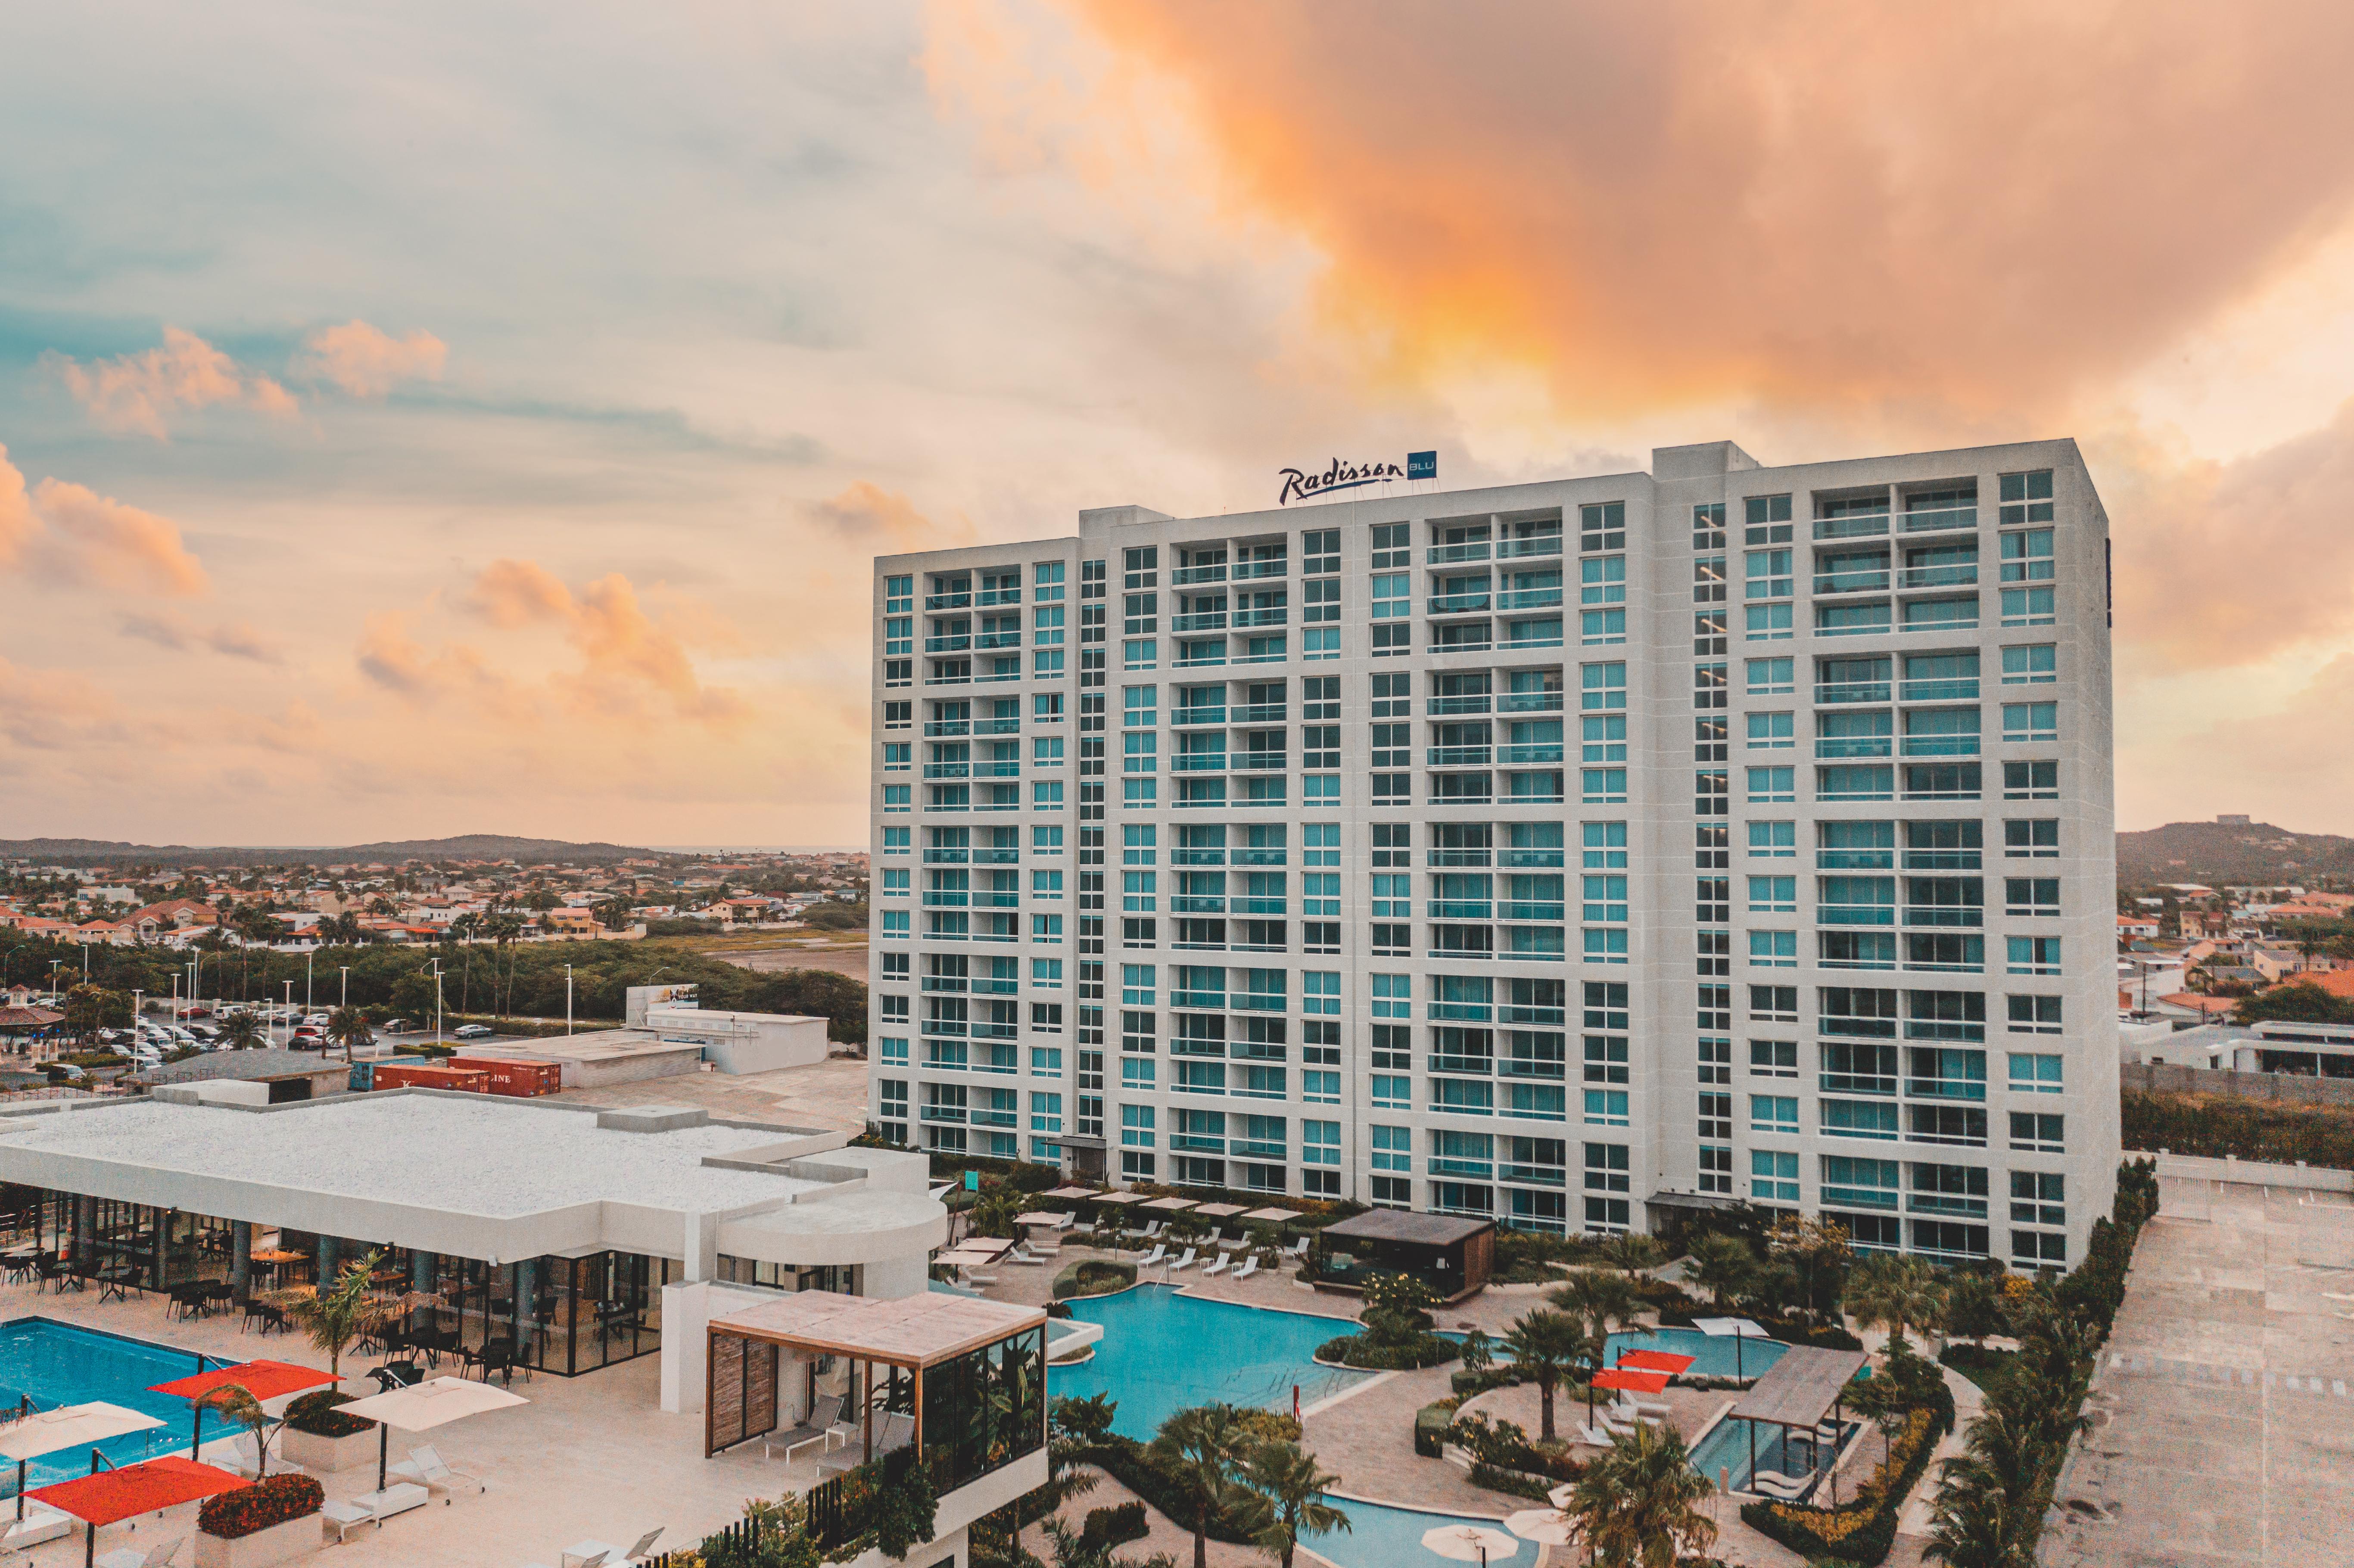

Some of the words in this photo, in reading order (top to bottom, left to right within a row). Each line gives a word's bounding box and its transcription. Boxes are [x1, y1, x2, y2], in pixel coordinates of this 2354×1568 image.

[1279, 457, 1404, 506] Radisson
[1409, 462, 1434, 471] BLU
[490, 1074, 511, 1083] INE
